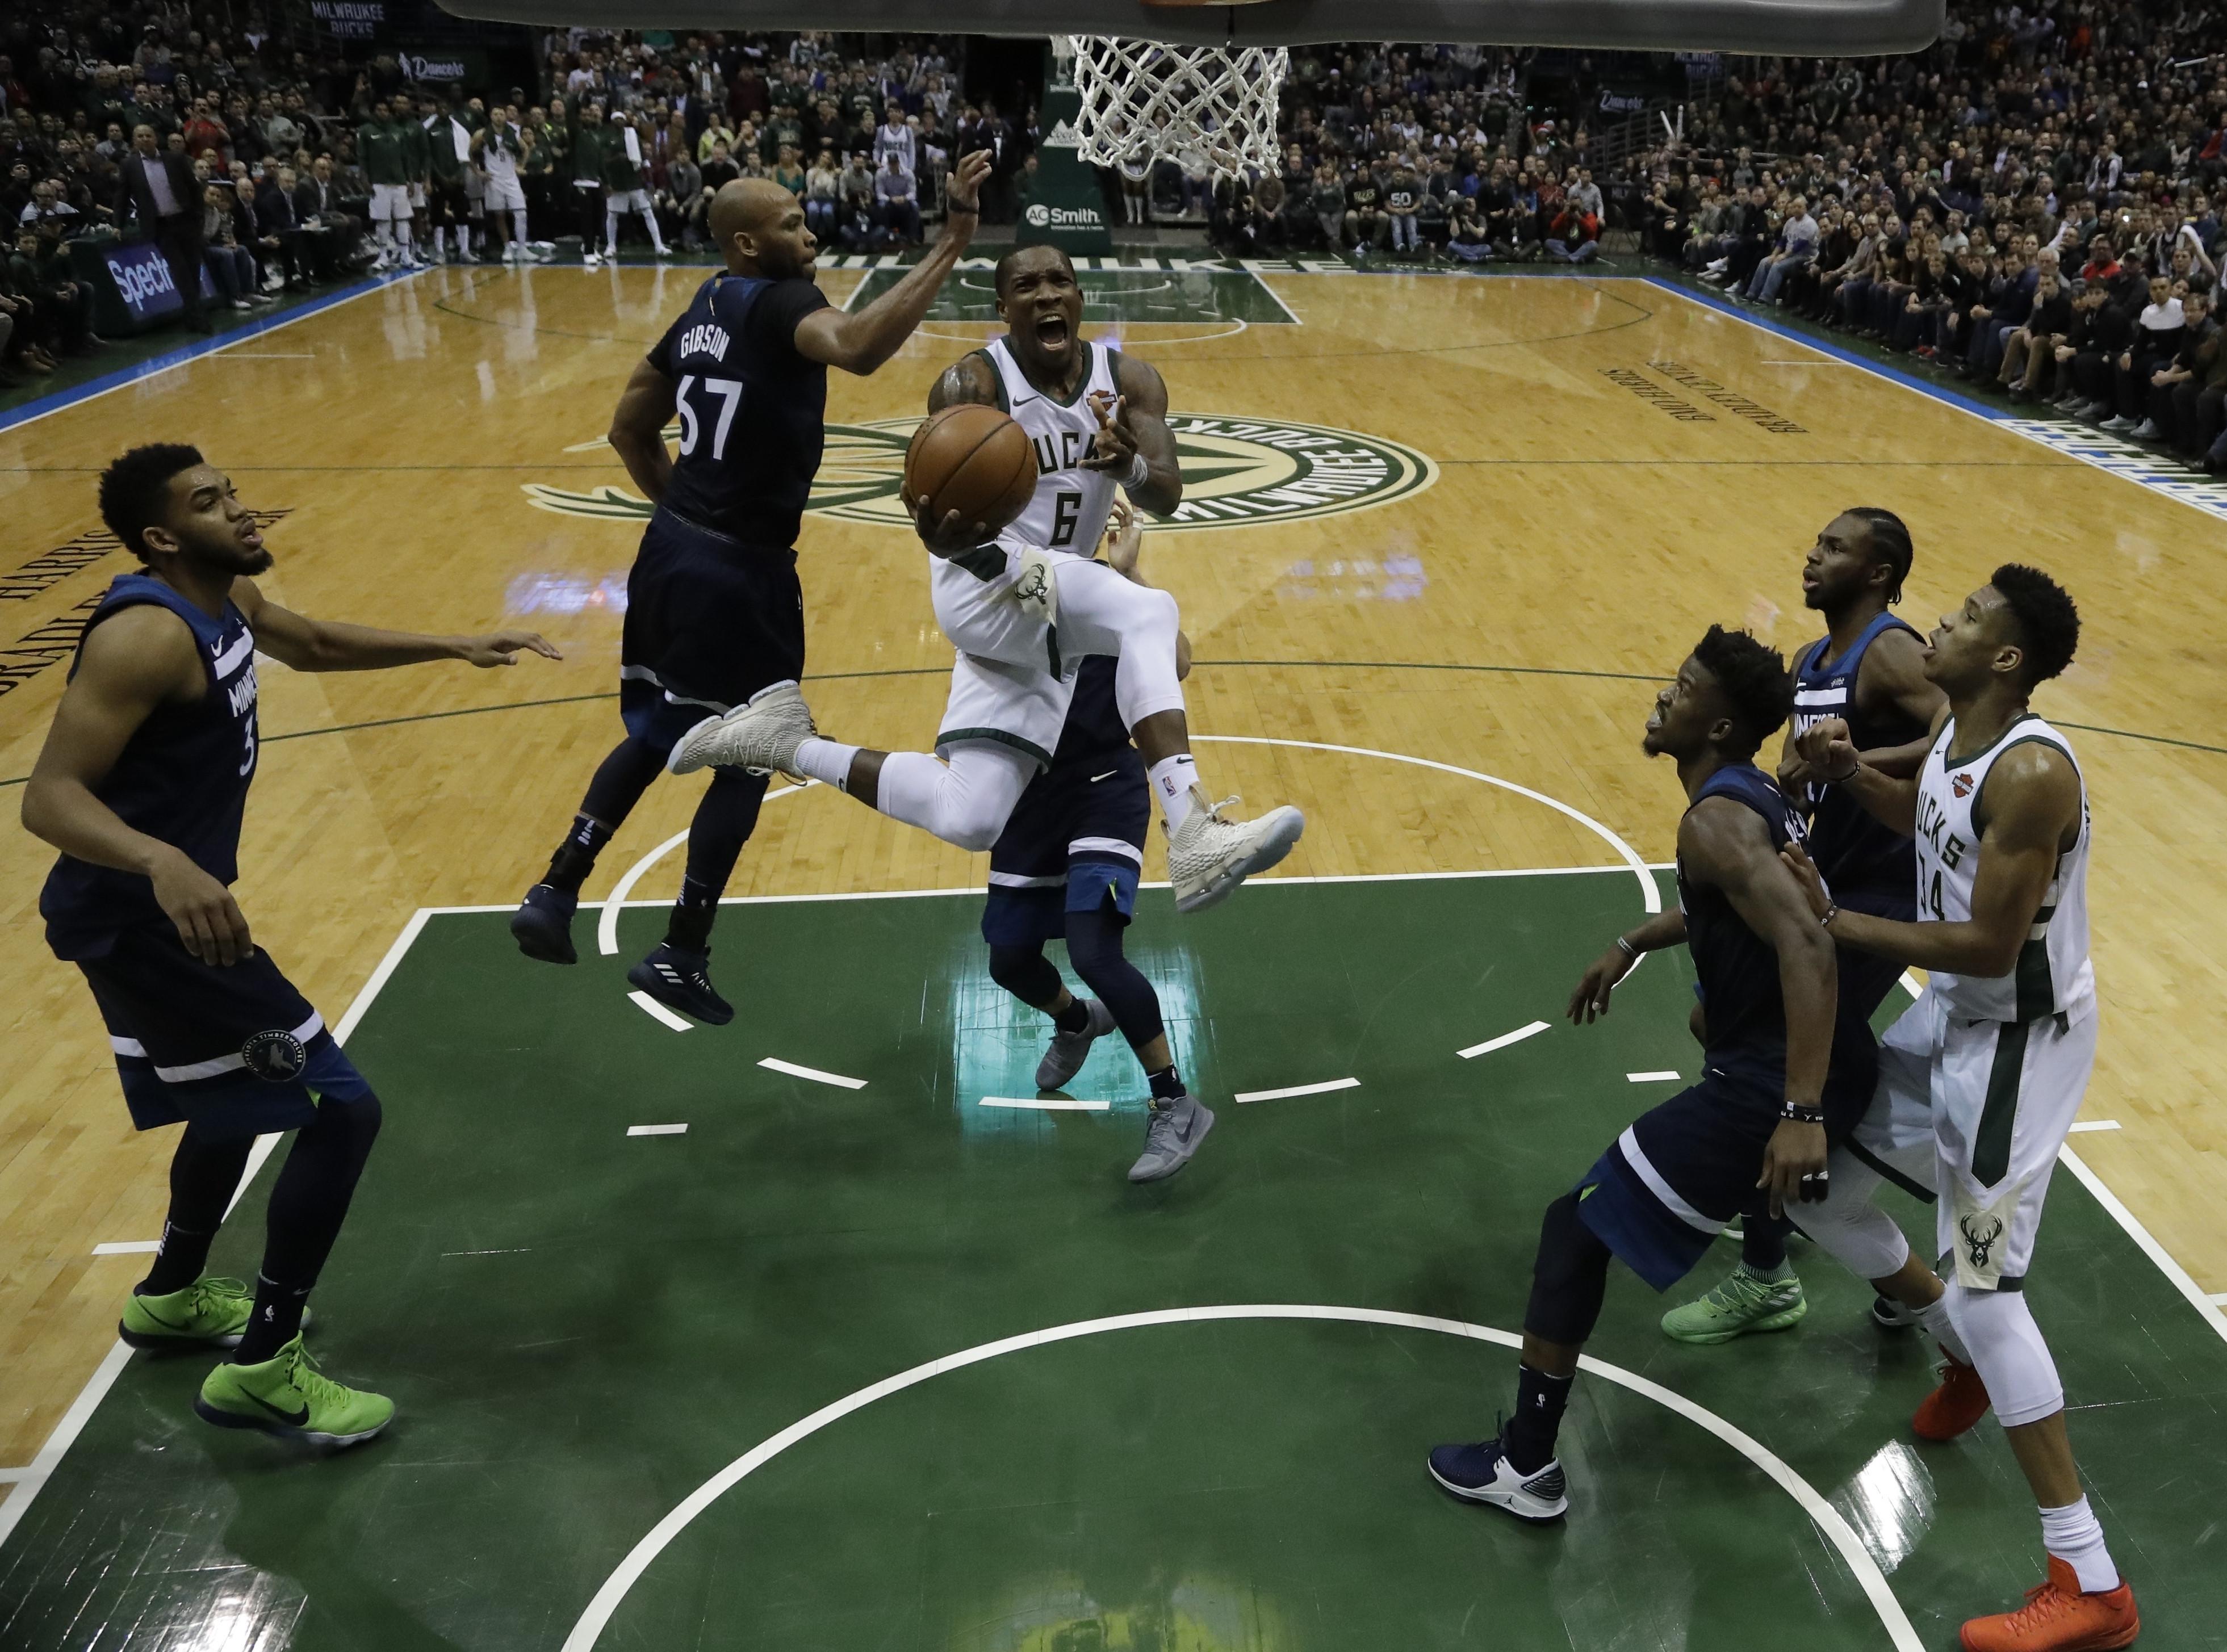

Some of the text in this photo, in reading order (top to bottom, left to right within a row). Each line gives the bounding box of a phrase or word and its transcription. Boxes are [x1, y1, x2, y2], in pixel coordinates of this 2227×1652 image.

[311, 1, 386, 21] MILWAUKEE
[330, 20, 375, 39] BUCKS
[411, 56, 465, 81] Dancers
[1390, 191, 1412, 207] 50
[108, 251, 174, 311] Spectr
[681, 324, 730, 363] GIBSON
[676, 375, 743, 460] 67
[1705, 393, 1810, 433] BRADLEY
[1171, 448, 1388, 522] MILWAUKEE
[1049, 492, 1082, 546] 6
[240, 714, 254, 776] 3
[259, 1033, 303, 1063] TIMBERWOLVES
